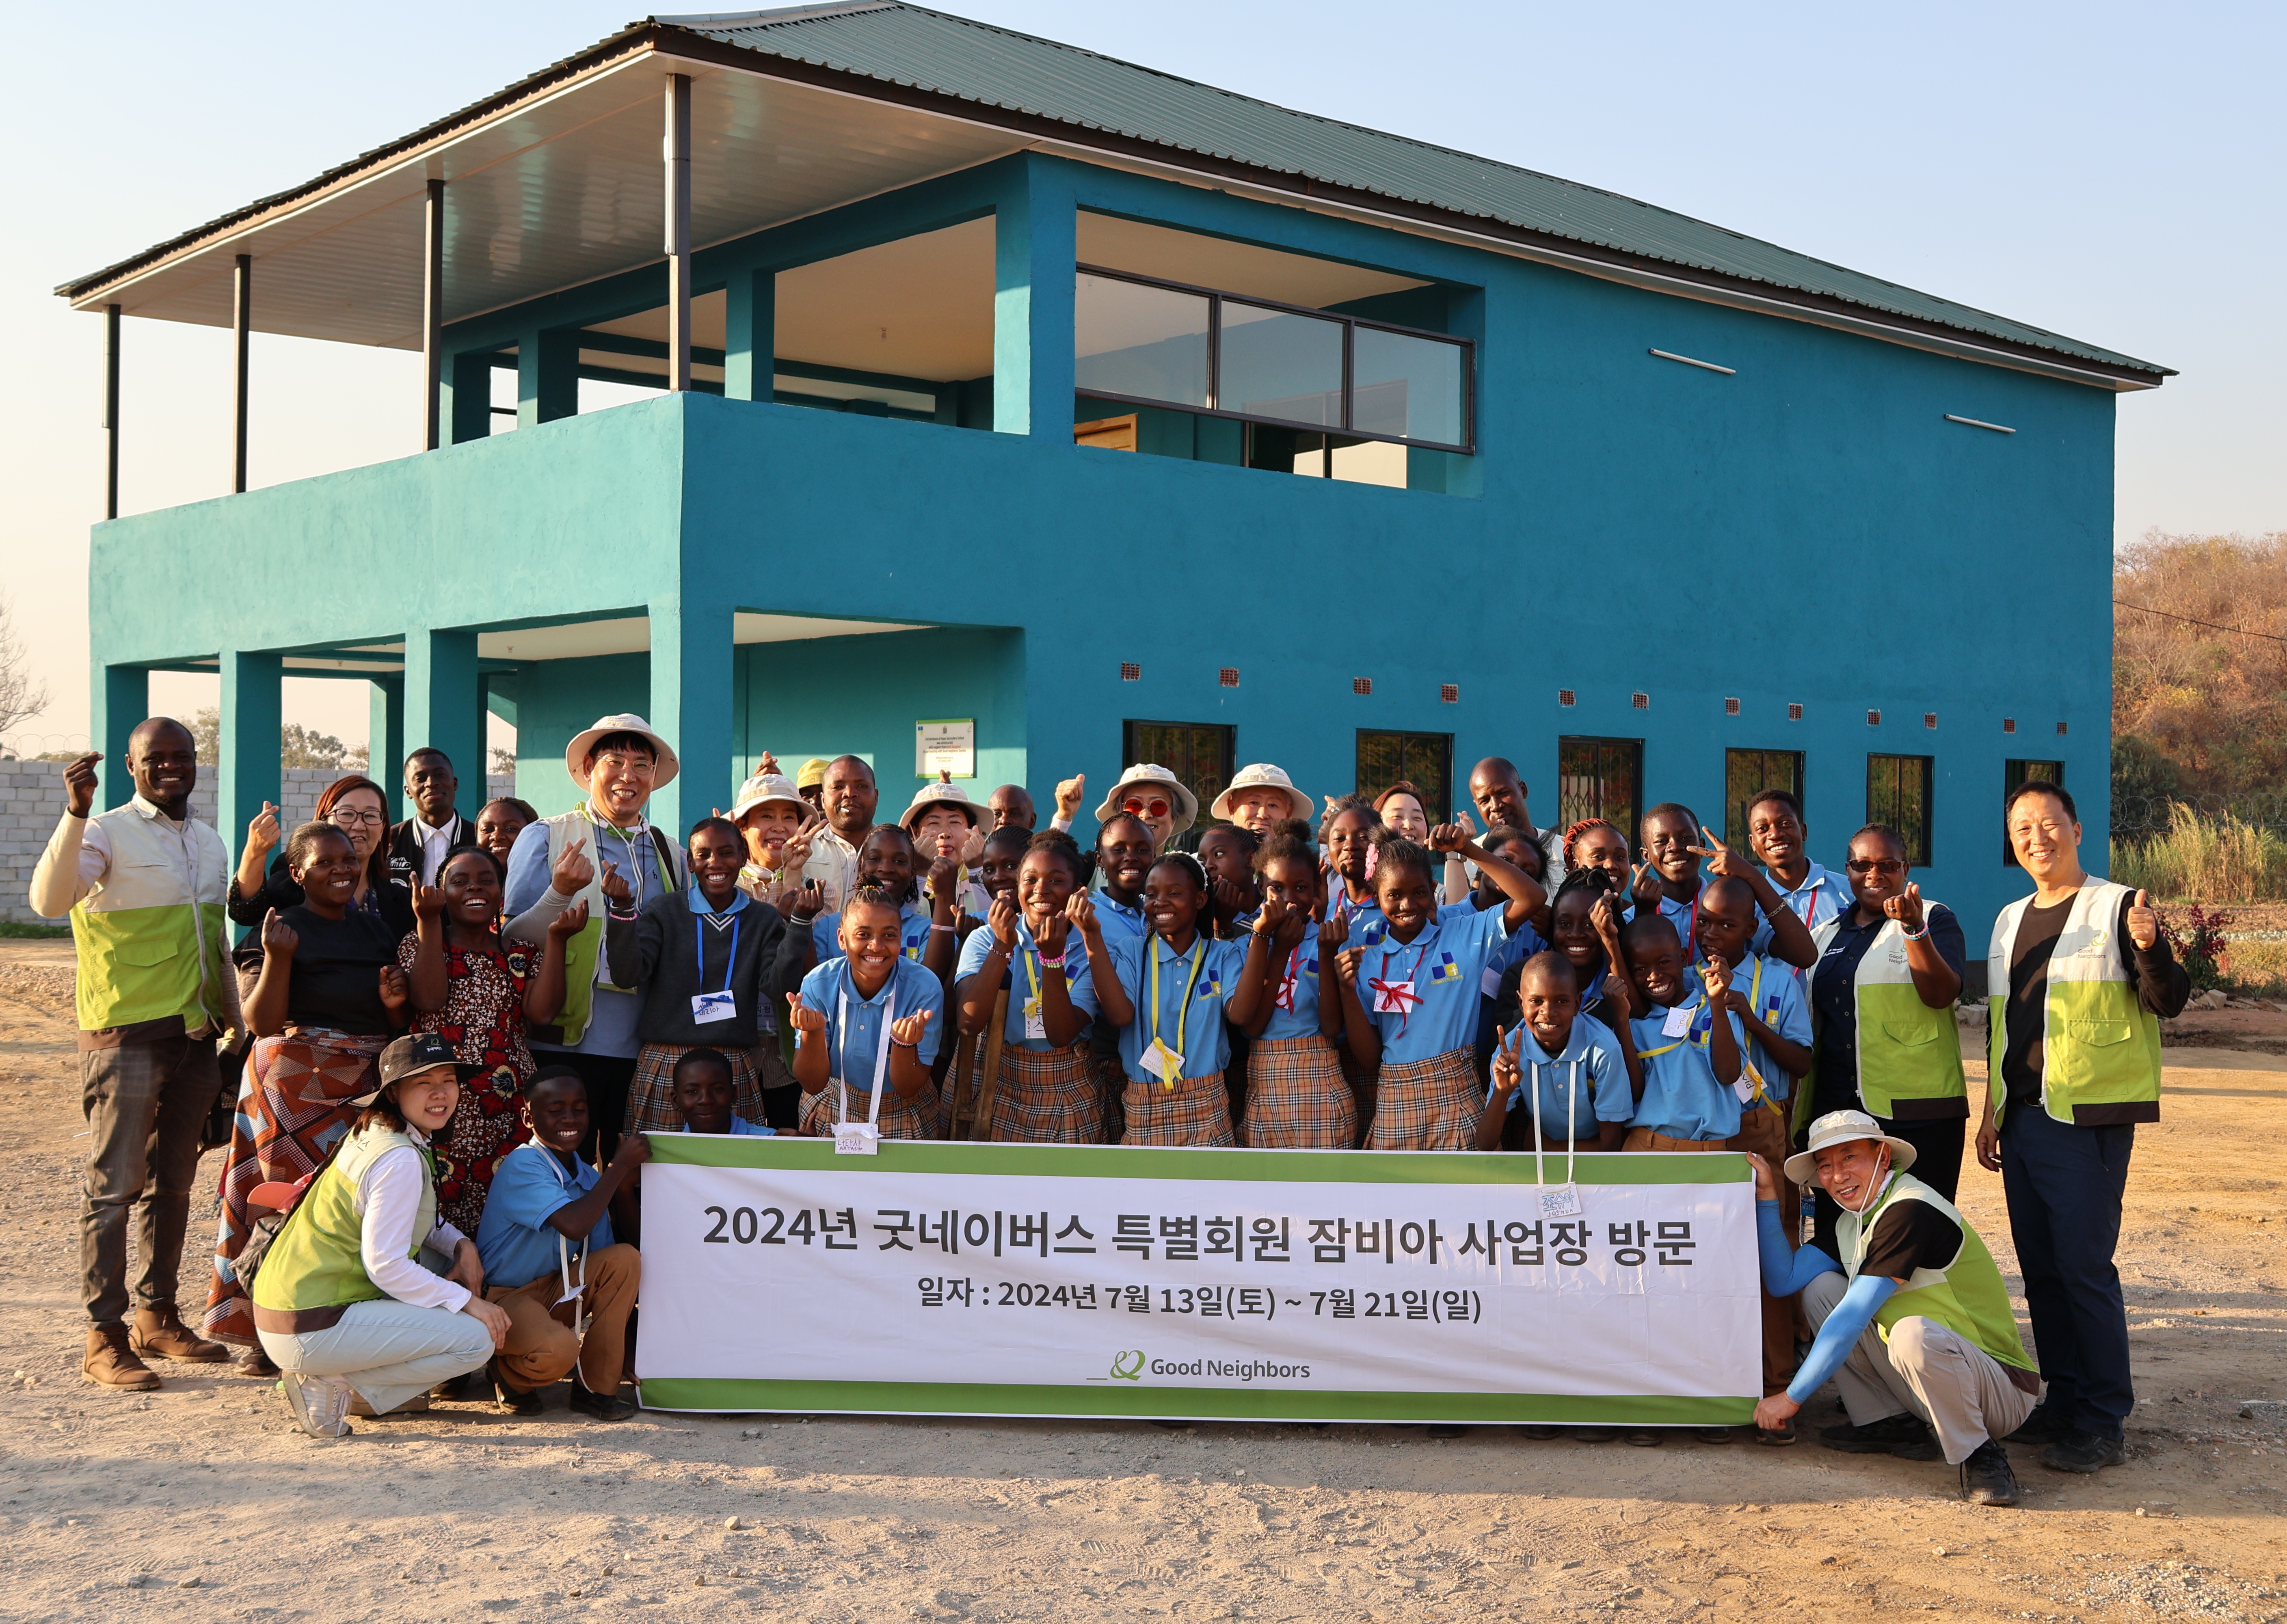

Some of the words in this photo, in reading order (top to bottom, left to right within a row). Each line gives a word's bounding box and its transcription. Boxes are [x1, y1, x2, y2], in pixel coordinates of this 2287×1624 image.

[838, 1138, 862, 1147] 나타샤
[1547, 1208, 1574, 1217] JOSHUA
[704, 1206, 857, 1249] 2024년
[873, 1210, 1096, 1257] 굿네이버스
[1112, 1215, 1290, 1261] 특별회원
[1308, 1218, 1443, 1264] 잠비아
[1458, 1220, 1592, 1266] 사업장
[1609, 1220, 1695, 1266] 방문
[919, 1277, 974, 1307] 일자
[999, 1282, 1097, 1309] 2024년
[1105, 1285, 1150, 1313] 7월
[1161, 1287, 1275, 1320] 13일(토)
[1310, 1289, 1355, 1318] 7월
[1365, 1290, 1480, 1324] 21일(일)
[1151, 1359, 1202, 1376] Good
[1207, 1360, 1310, 1381] Neighbors
